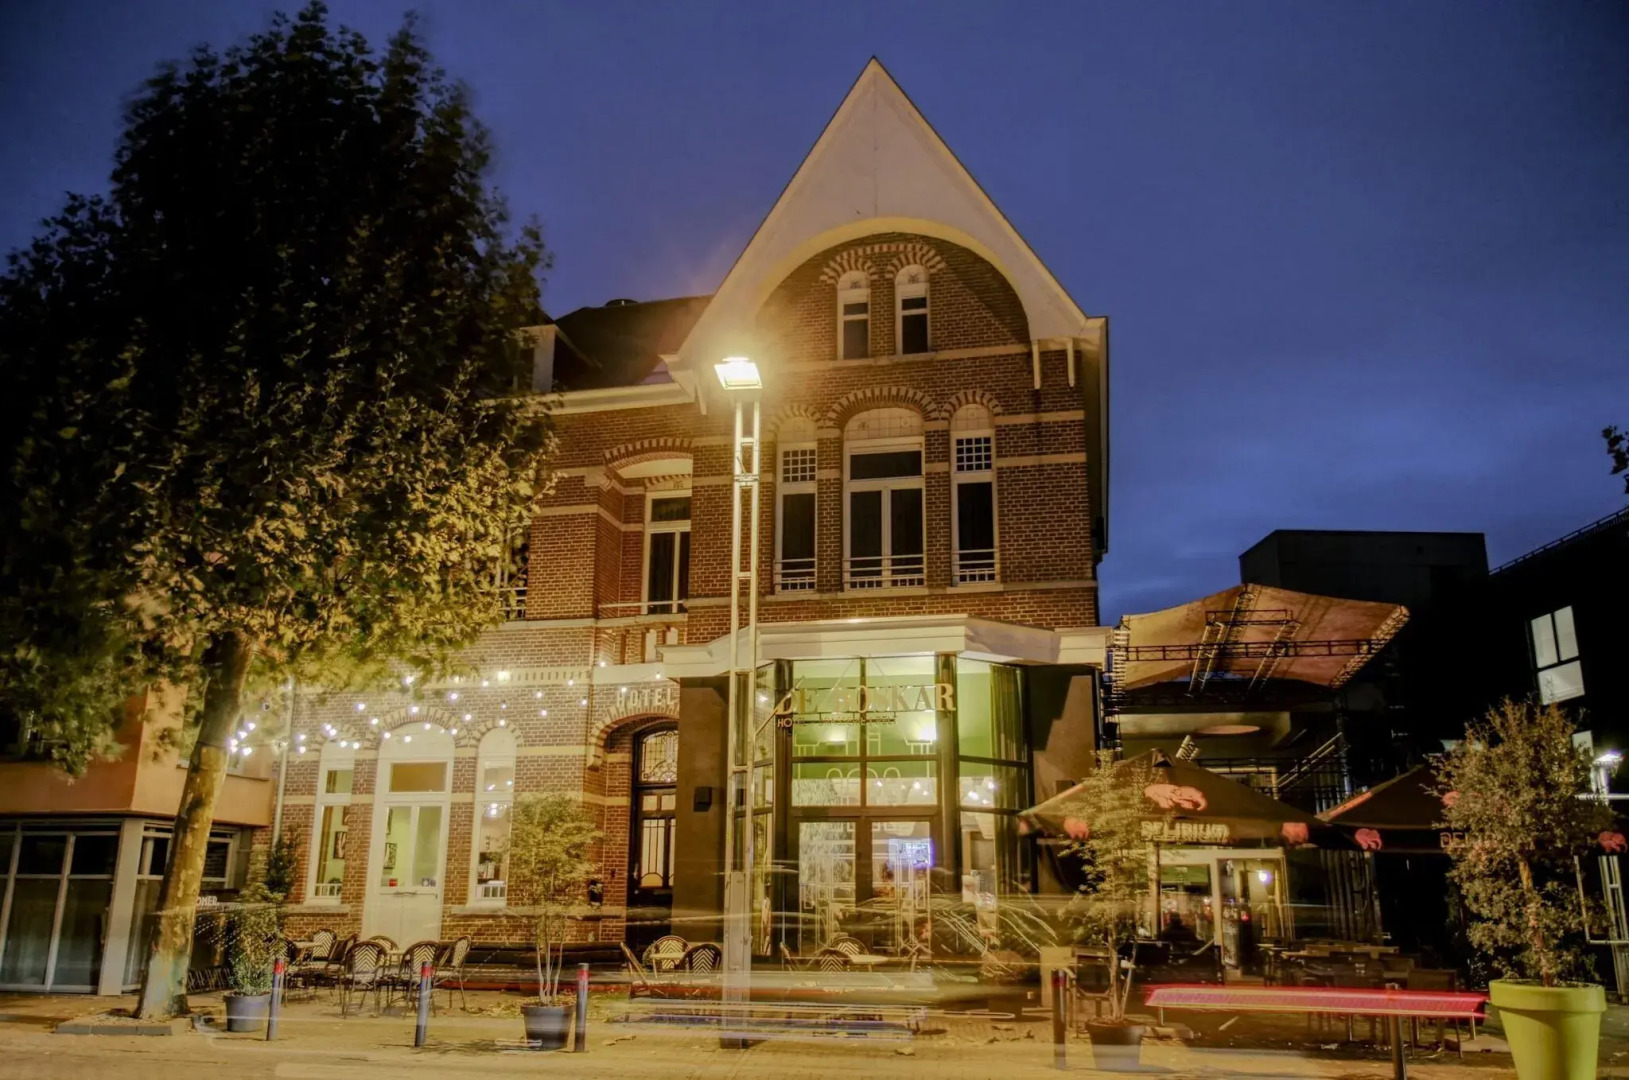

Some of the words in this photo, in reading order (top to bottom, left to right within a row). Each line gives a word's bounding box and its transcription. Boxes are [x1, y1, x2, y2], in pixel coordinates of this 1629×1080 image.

[617, 687, 674, 707] HOTEL
[776, 686, 818, 716] DE
[1140, 821, 1230, 842] DELIRIUM
